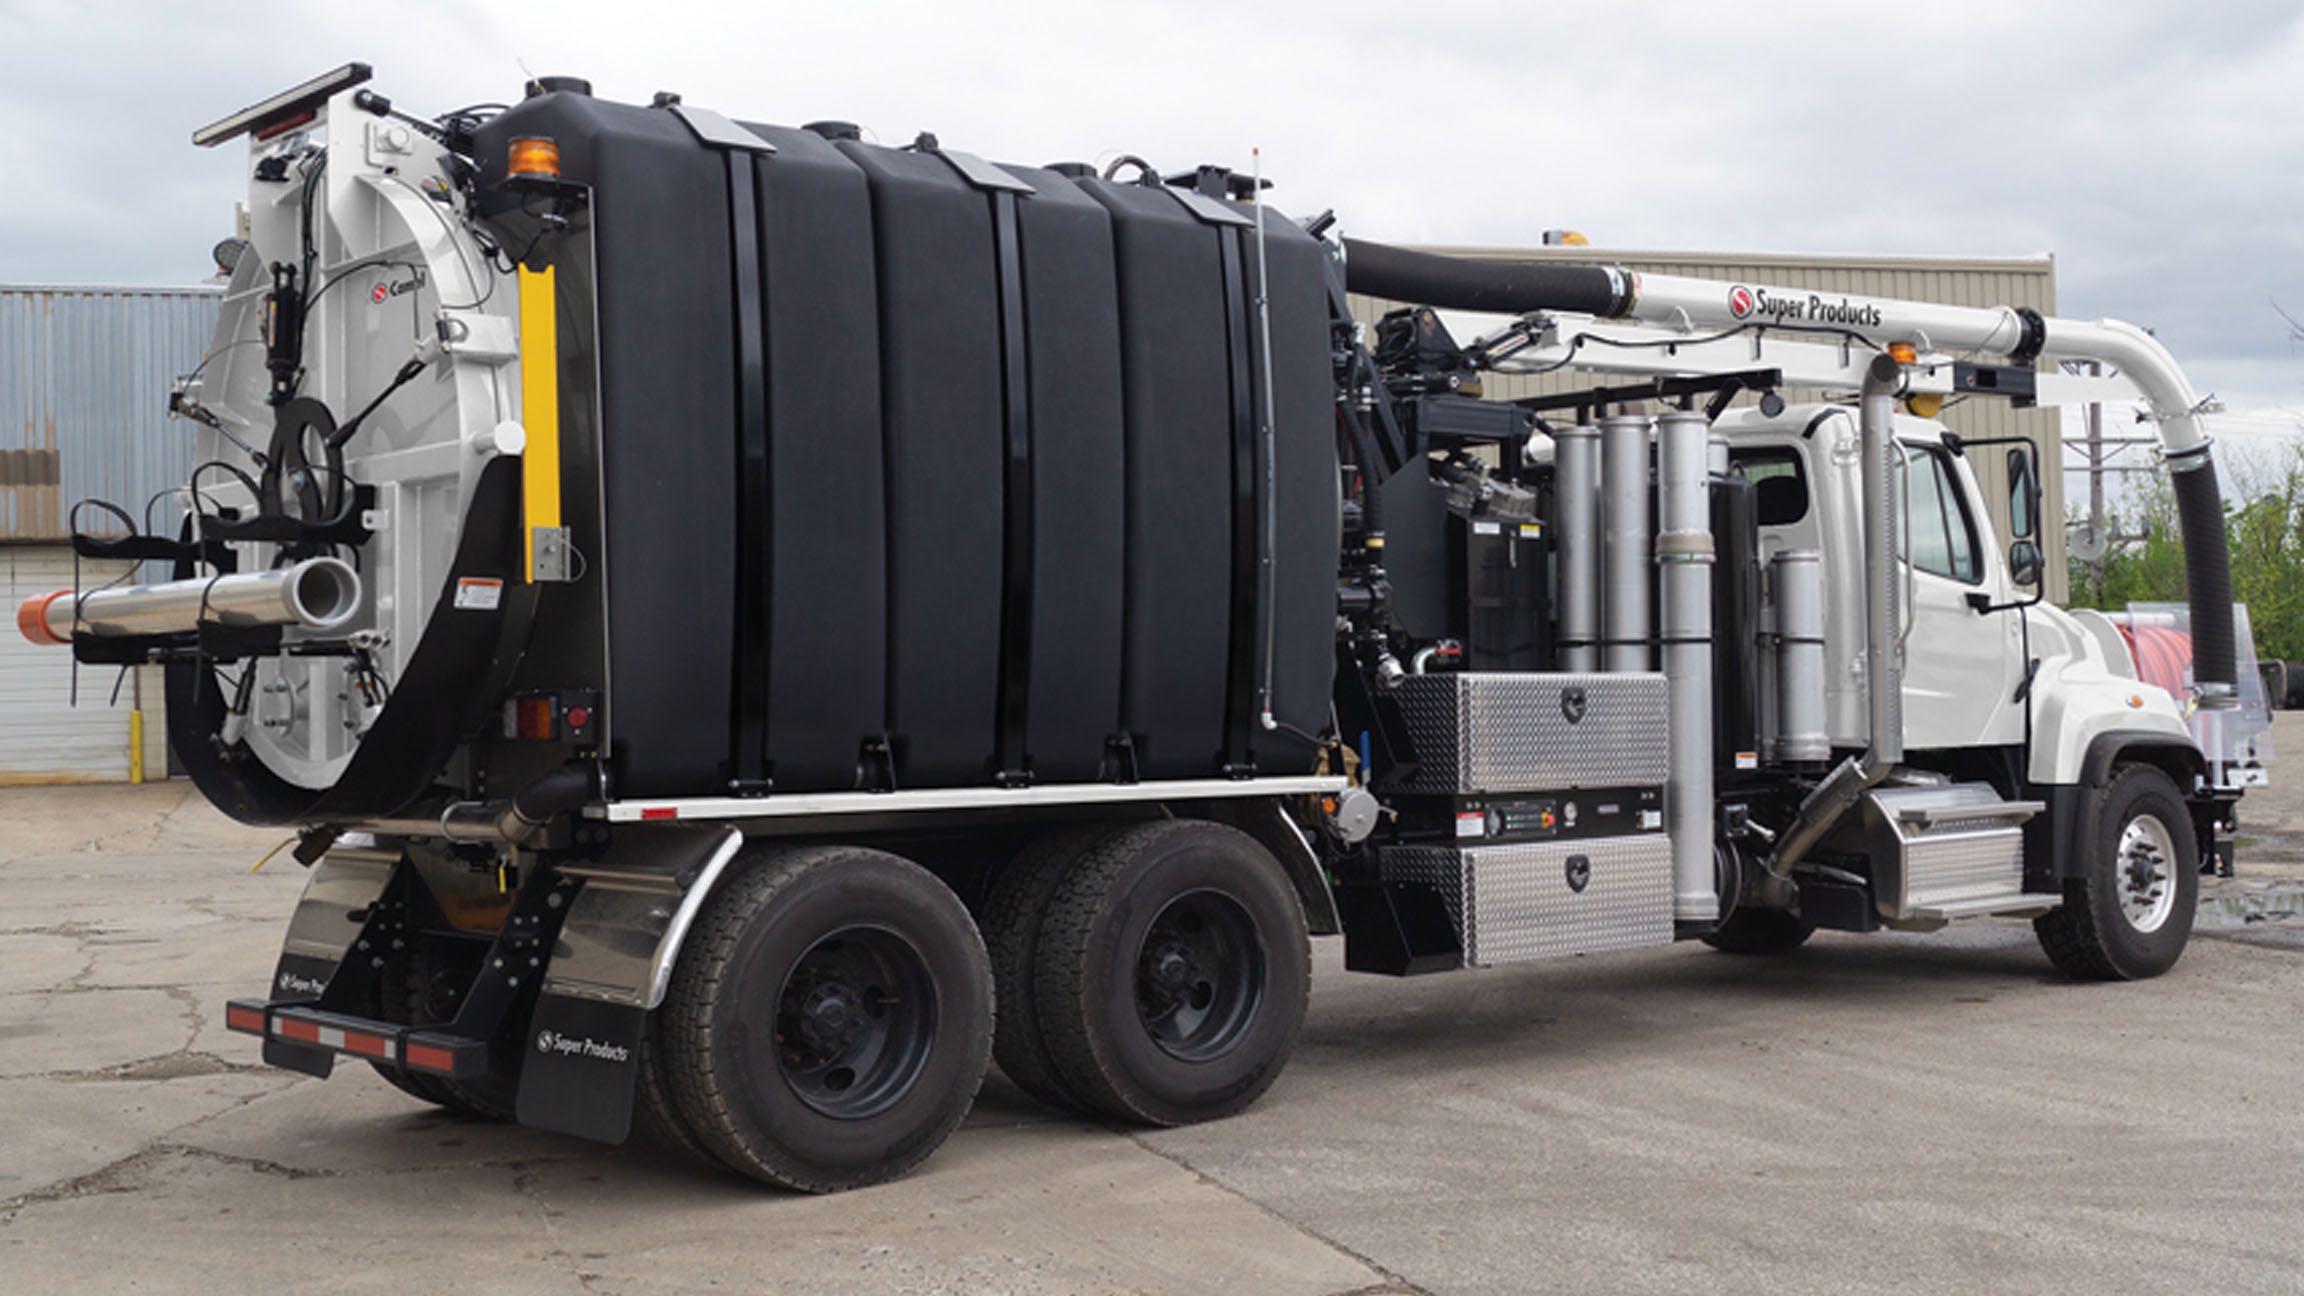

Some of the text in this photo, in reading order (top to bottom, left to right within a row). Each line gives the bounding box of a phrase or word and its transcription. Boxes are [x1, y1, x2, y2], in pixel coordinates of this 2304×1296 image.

[1757, 288, 1882, 327] Super Products
[553, 1033, 629, 1062] Super Products
